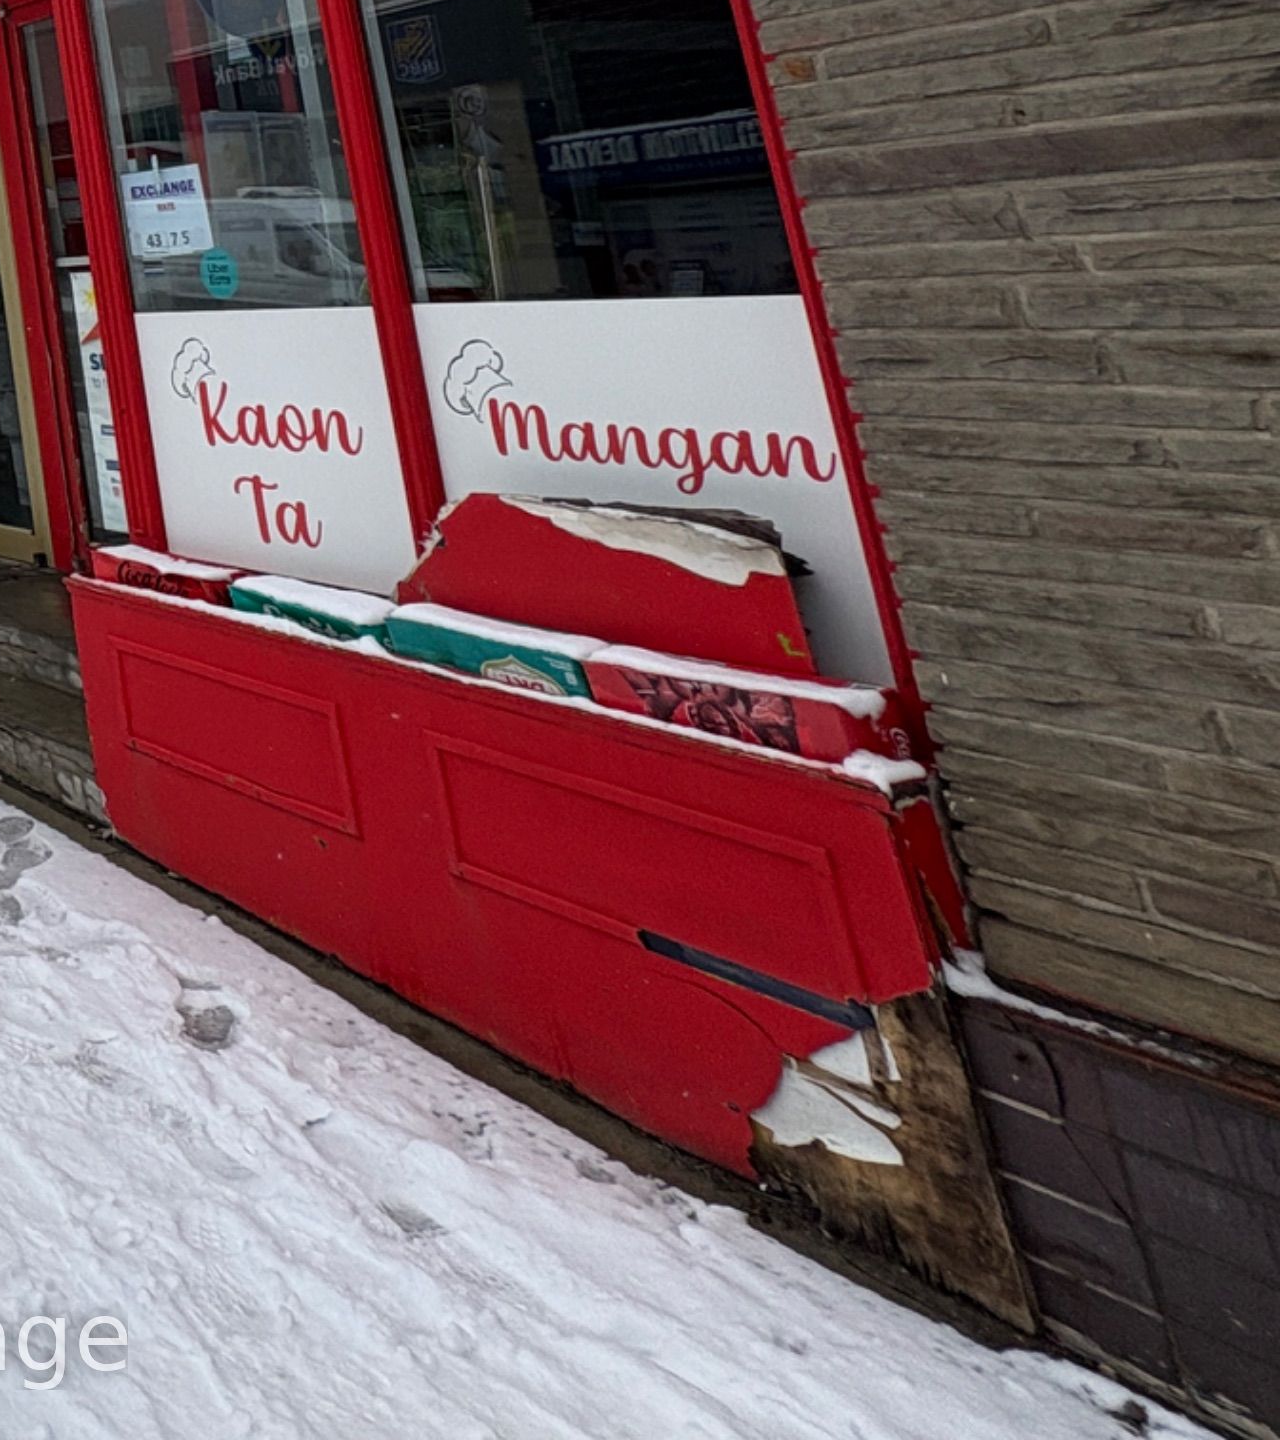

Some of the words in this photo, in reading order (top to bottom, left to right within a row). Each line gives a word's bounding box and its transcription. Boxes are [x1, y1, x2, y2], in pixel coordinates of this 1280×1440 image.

[197, 380, 362, 456] Kaon
[488, 397, 837, 495] Mangan
[234, 474, 322, 549] Ta
